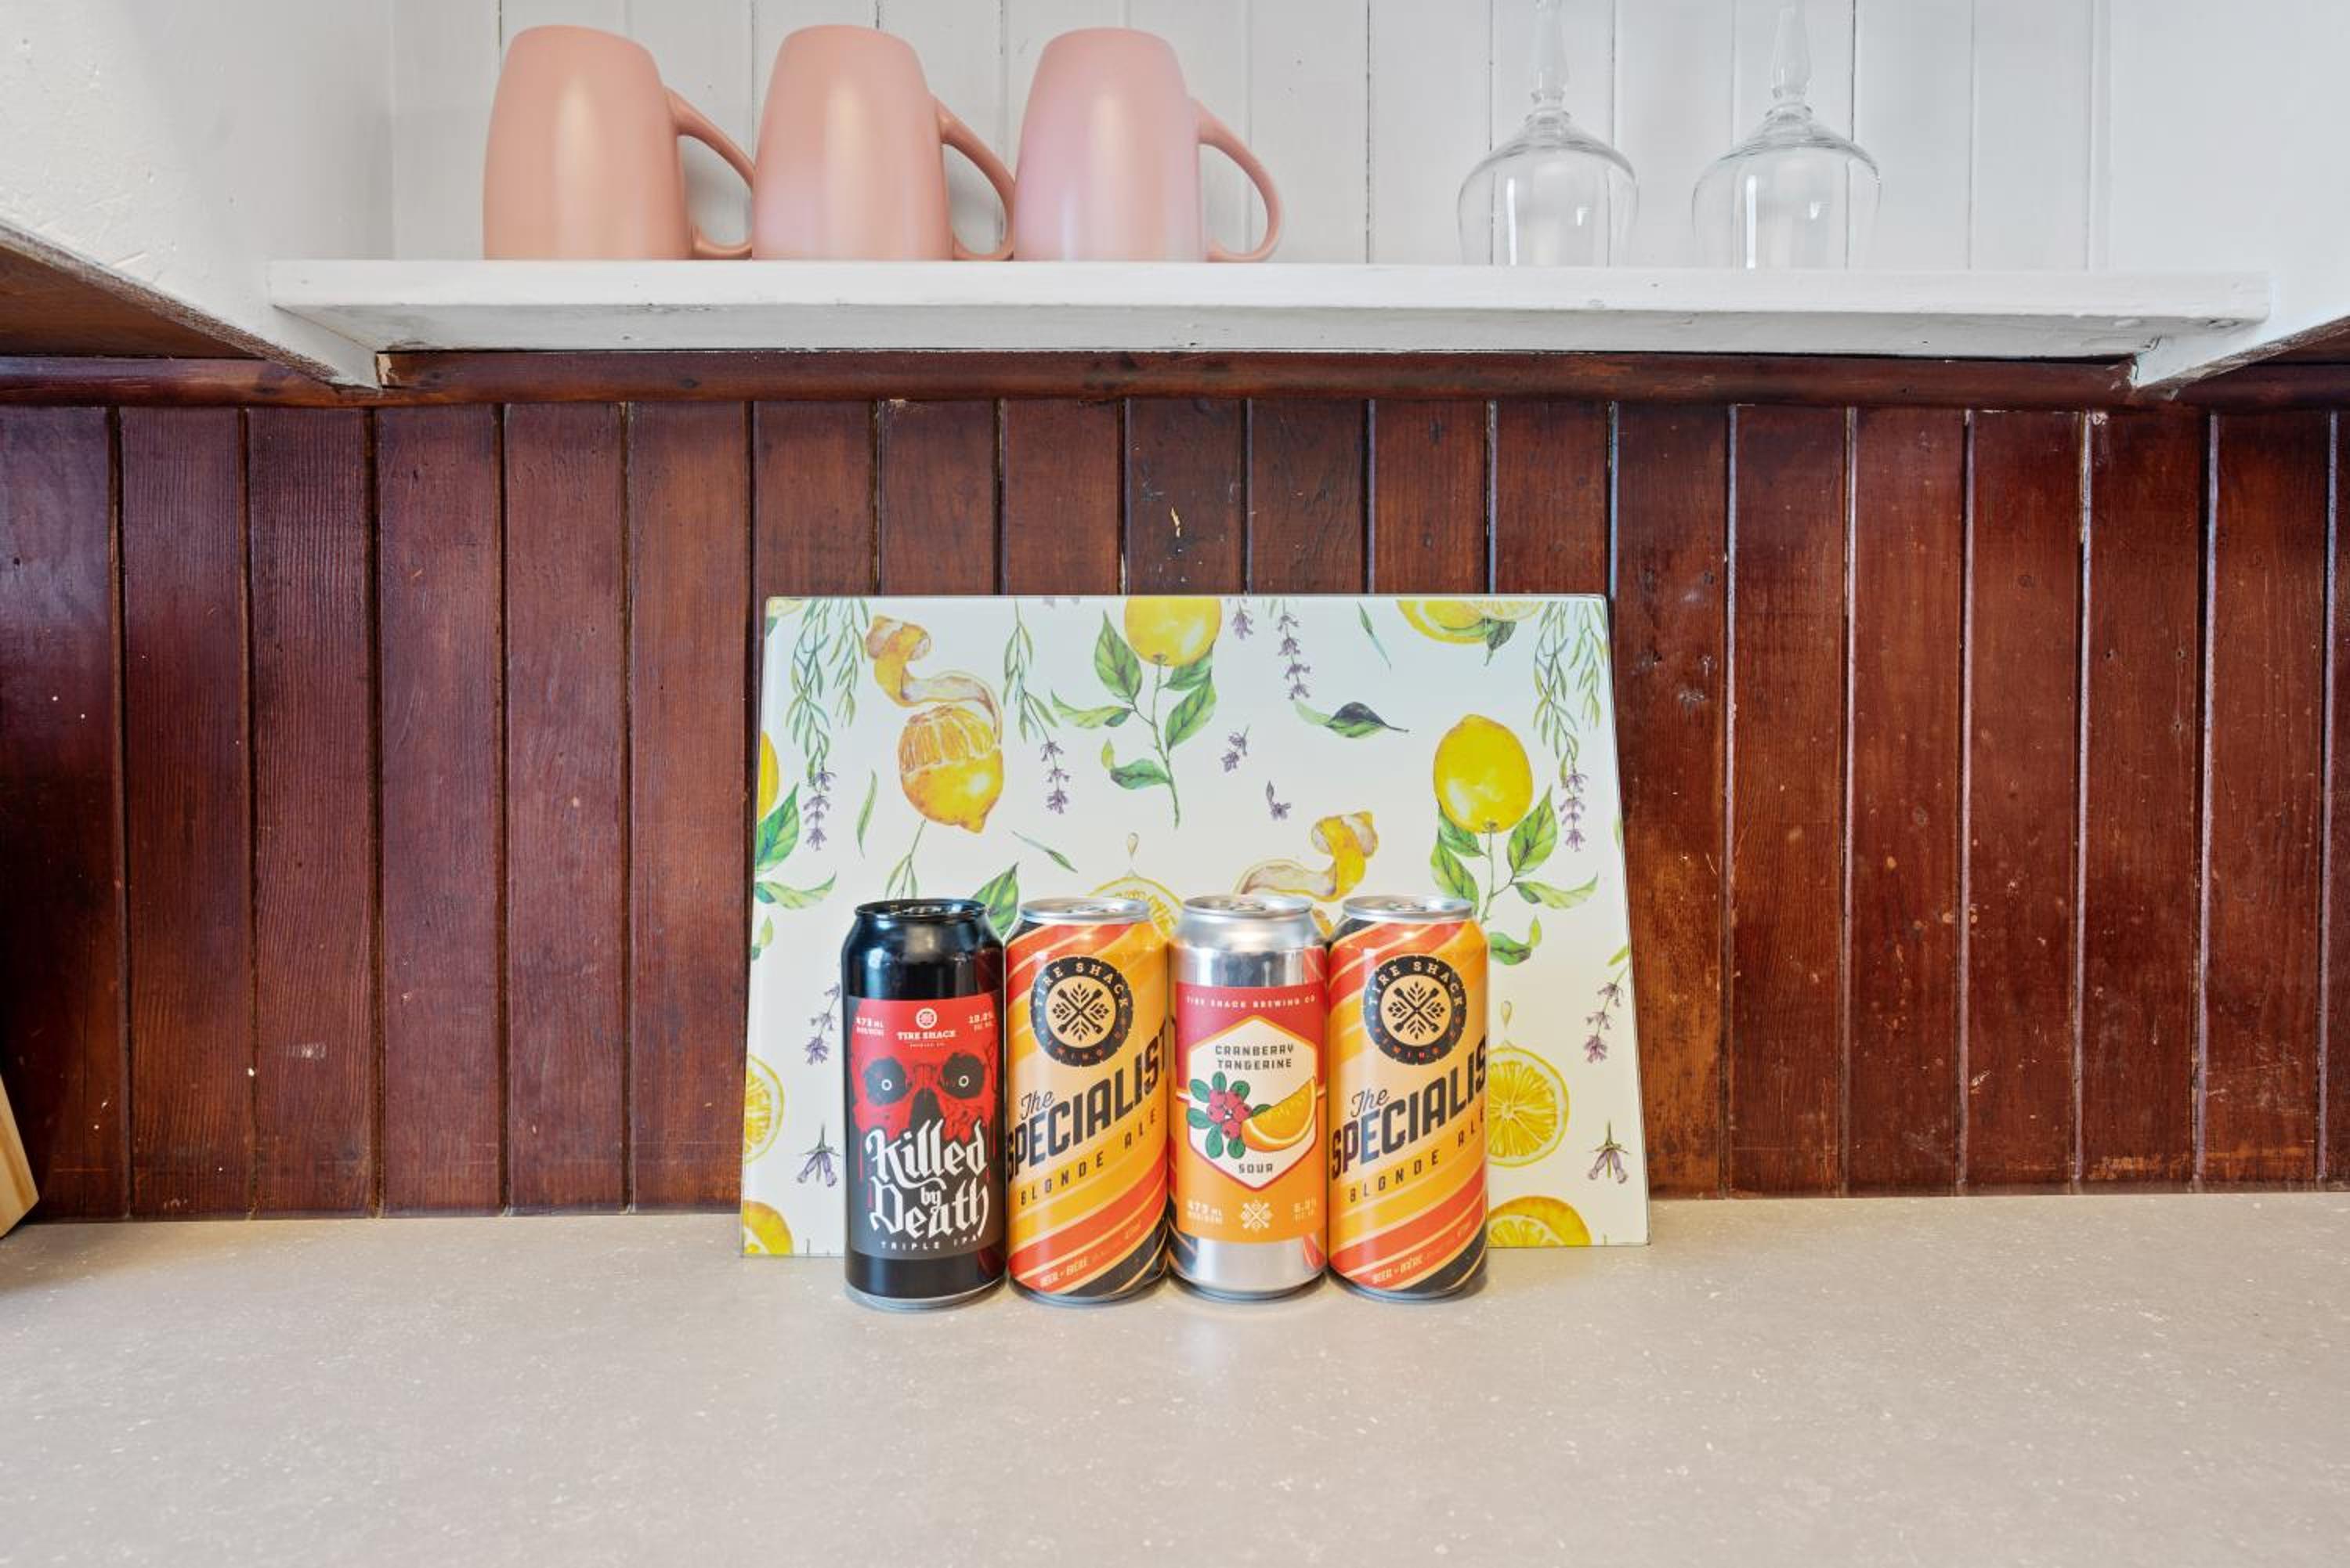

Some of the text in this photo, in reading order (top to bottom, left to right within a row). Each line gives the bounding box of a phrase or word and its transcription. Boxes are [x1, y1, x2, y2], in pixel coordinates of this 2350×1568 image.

[1034, 962, 1130, 1008] TIRE SHACK
[1368, 961, 1463, 1007] TIRE SHACK
[1210, 999, 1246, 1008] SHACK
[1253, 998, 1300, 1009] BREWING
[1215, 1043, 1295, 1057] CRANBERRY
[1217, 1058, 1292, 1071] TANGERINE
[1021, 1089, 1055, 1120] The
[1350, 1089, 1390, 1118] The
[865, 1118, 988, 1190] Killed
[1020, 1106, 1158, 1207] BLONDE ALE
[1238, 1163, 1274, 1174] SOUR
[1349, 1106, 1484, 1203] BLONDE ALE
[870, 1176, 989, 1240] Death
[920, 1186, 942, 1214] by
[881, 1240, 941, 1251] TRIPLE
